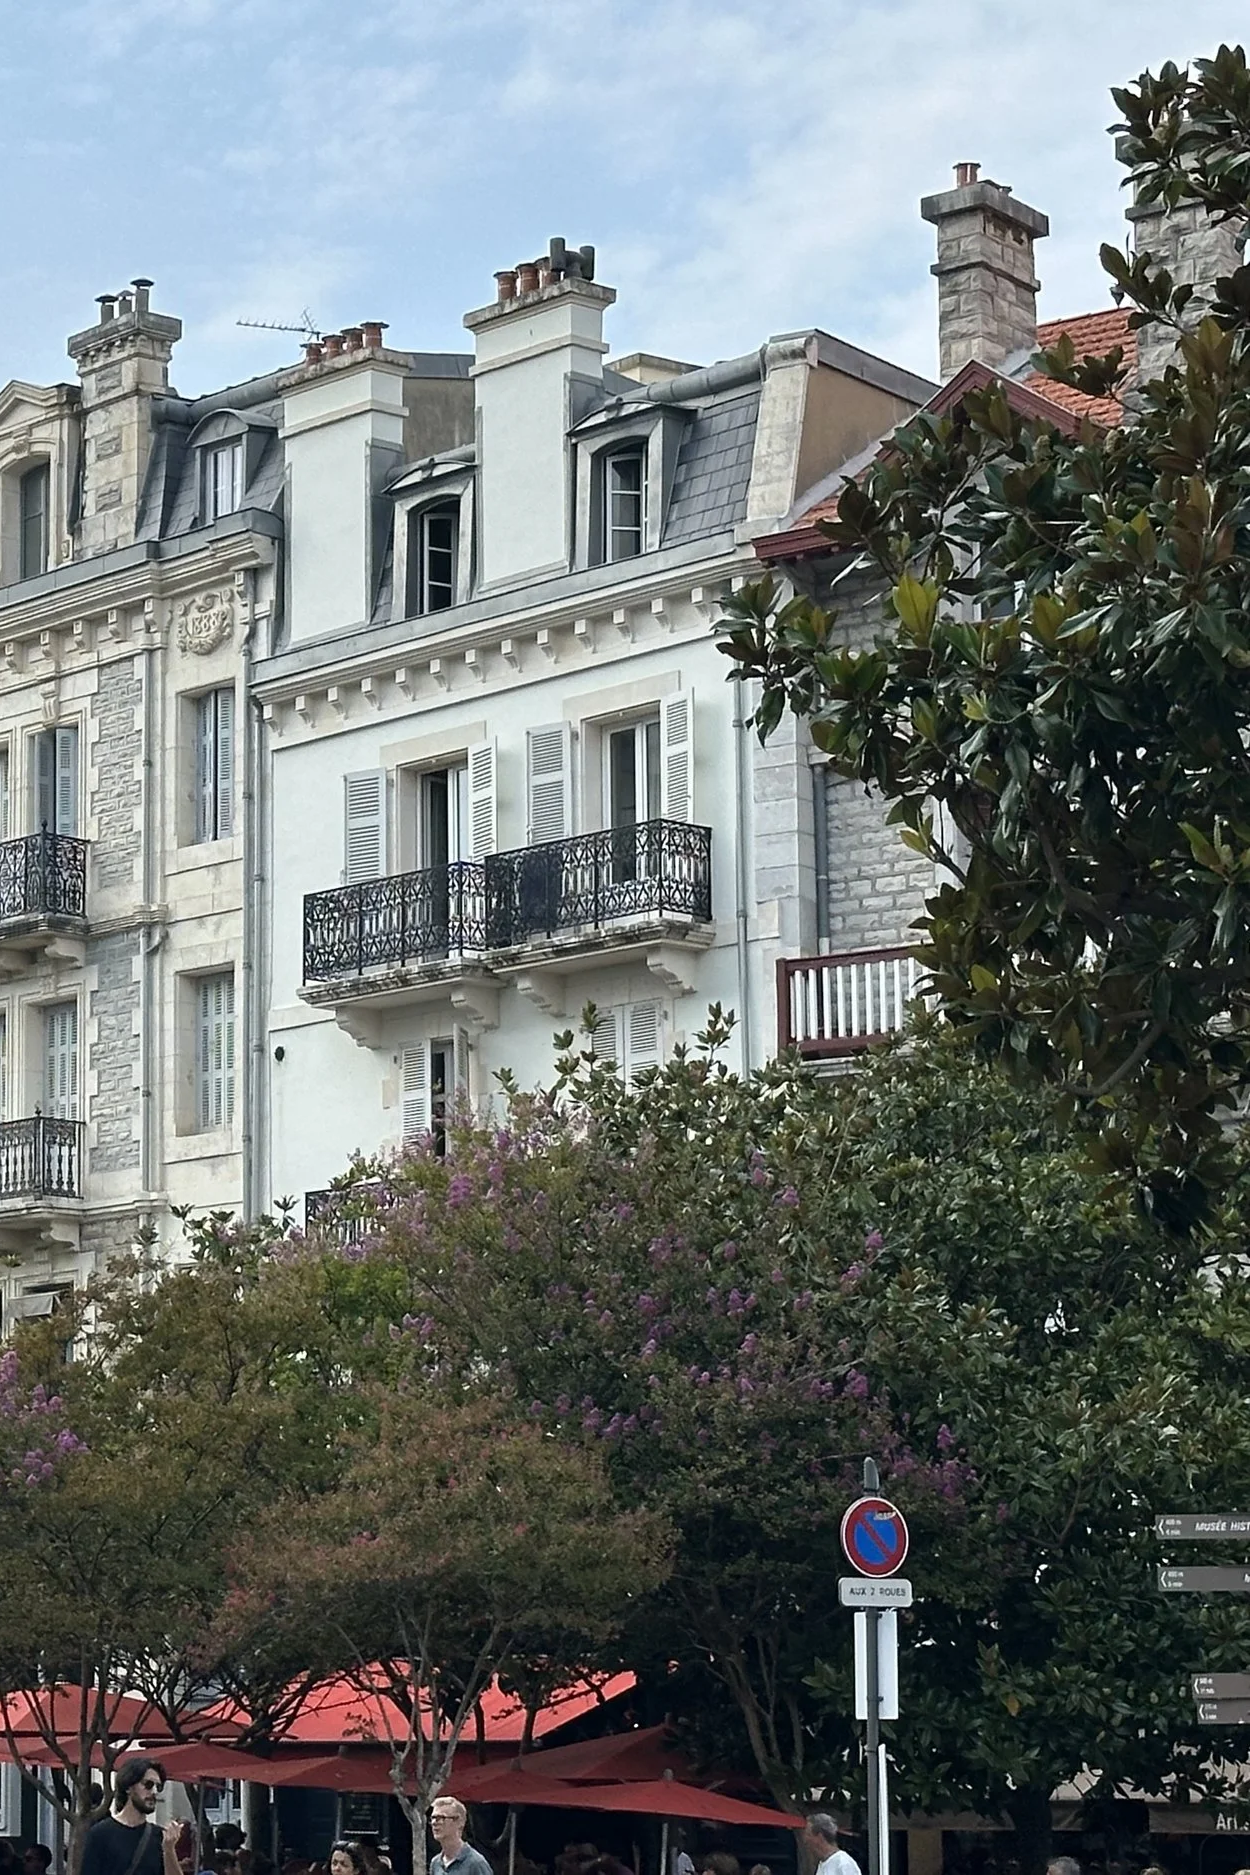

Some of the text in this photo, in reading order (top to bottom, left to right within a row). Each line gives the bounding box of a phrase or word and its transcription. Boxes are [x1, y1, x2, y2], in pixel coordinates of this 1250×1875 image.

[1195, 1519, 1227, 1532] MUSÉE
[849, 1587, 906, 1597] AUX 2 ROUES
